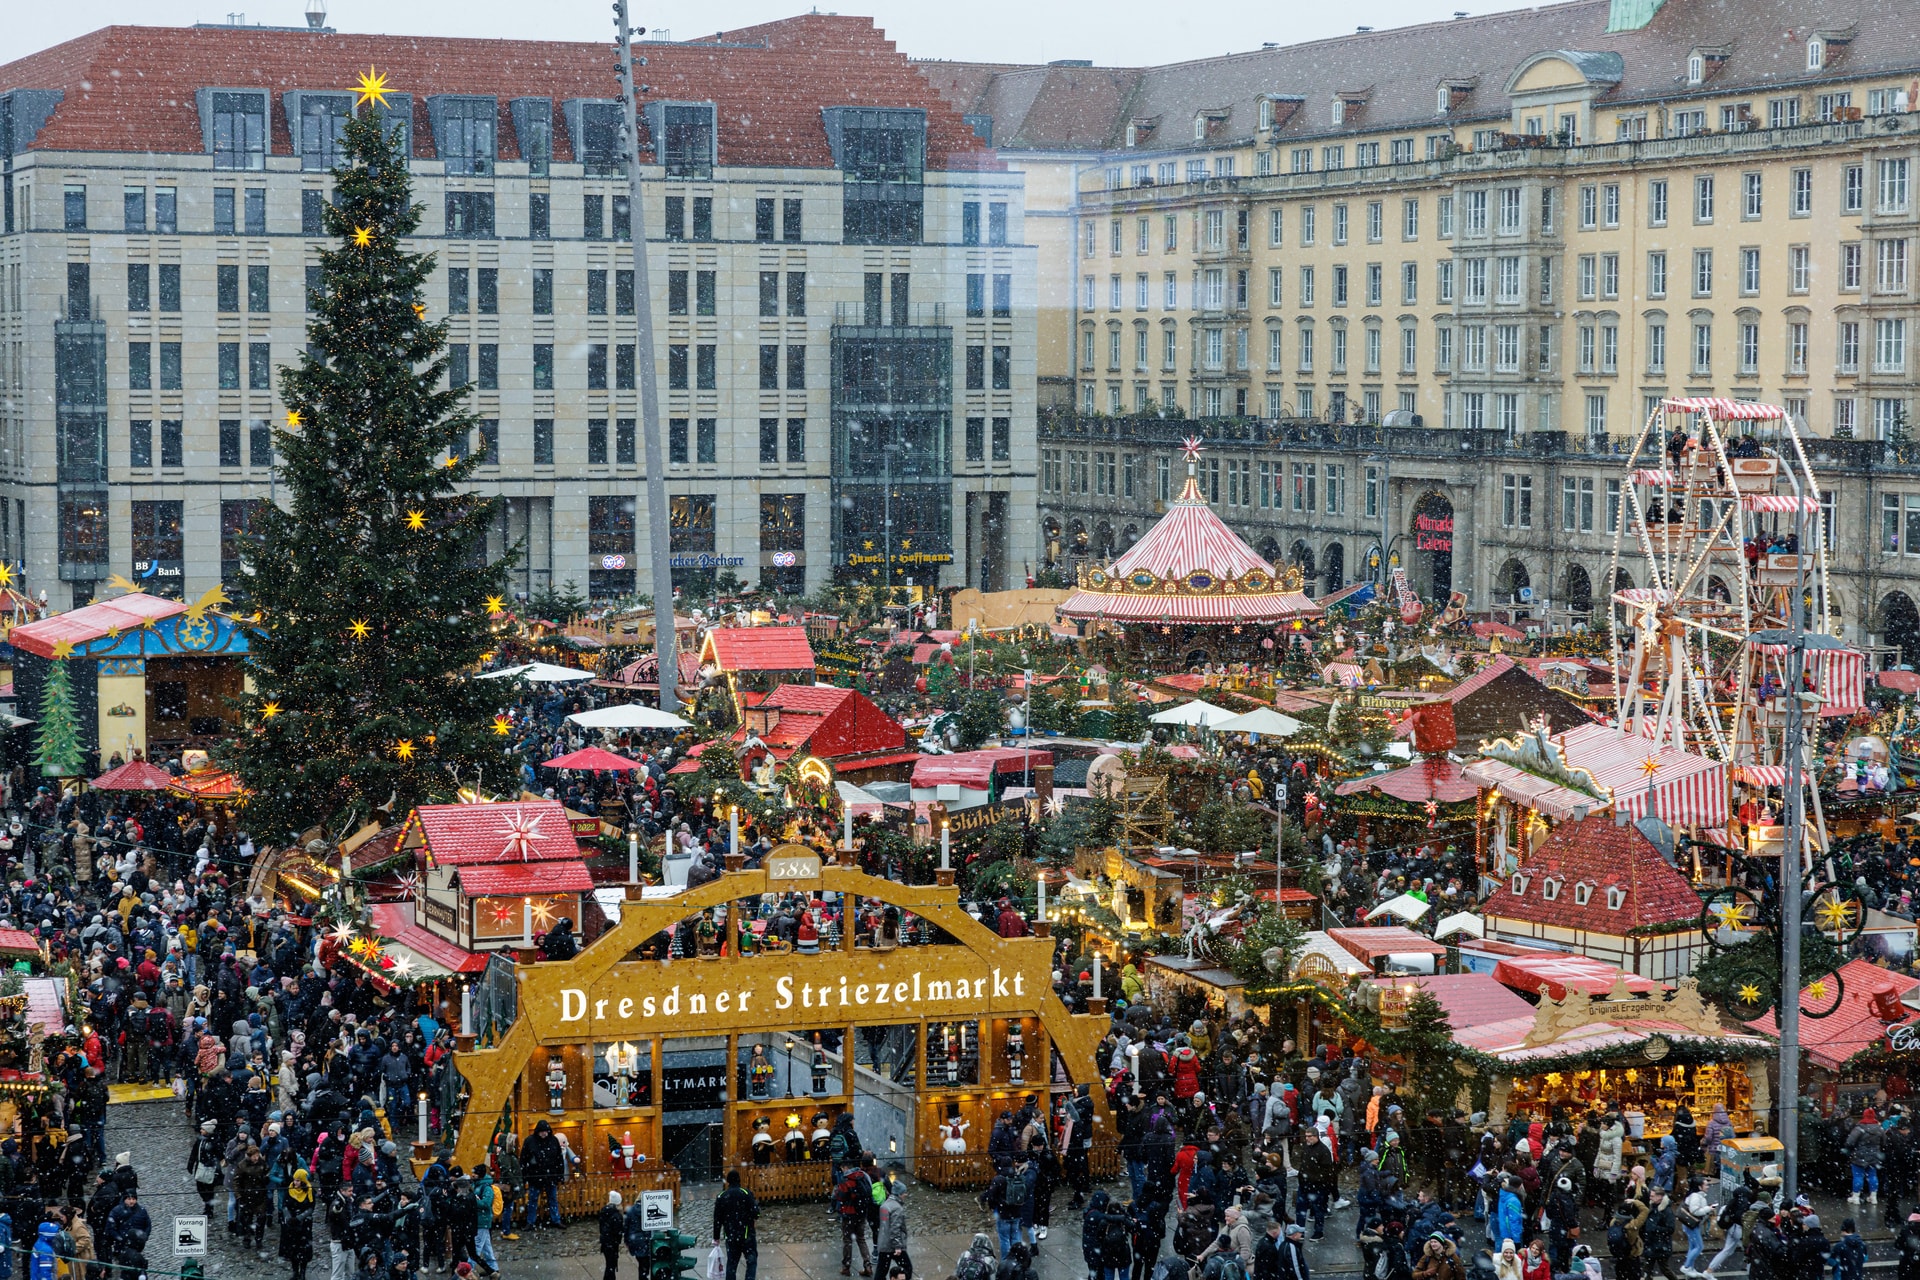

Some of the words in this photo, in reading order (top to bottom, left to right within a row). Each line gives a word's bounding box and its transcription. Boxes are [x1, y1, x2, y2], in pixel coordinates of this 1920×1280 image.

[1417, 533, 1452, 552] Galerie
[899, 552, 950, 565] Hoffmann
[135, 561, 149, 570] BB
[158, 567, 181, 576] Bank
[577, 823, 596, 832] 2022
[774, 862, 815, 877] 588.
[560, 984, 751, 1022] Dresdner
[775, 968, 1025, 1009] Striezelmarkt
[1589, 1004, 1619, 1015] Original
[1621, 1003, 1666, 1013] Erzgebirge
